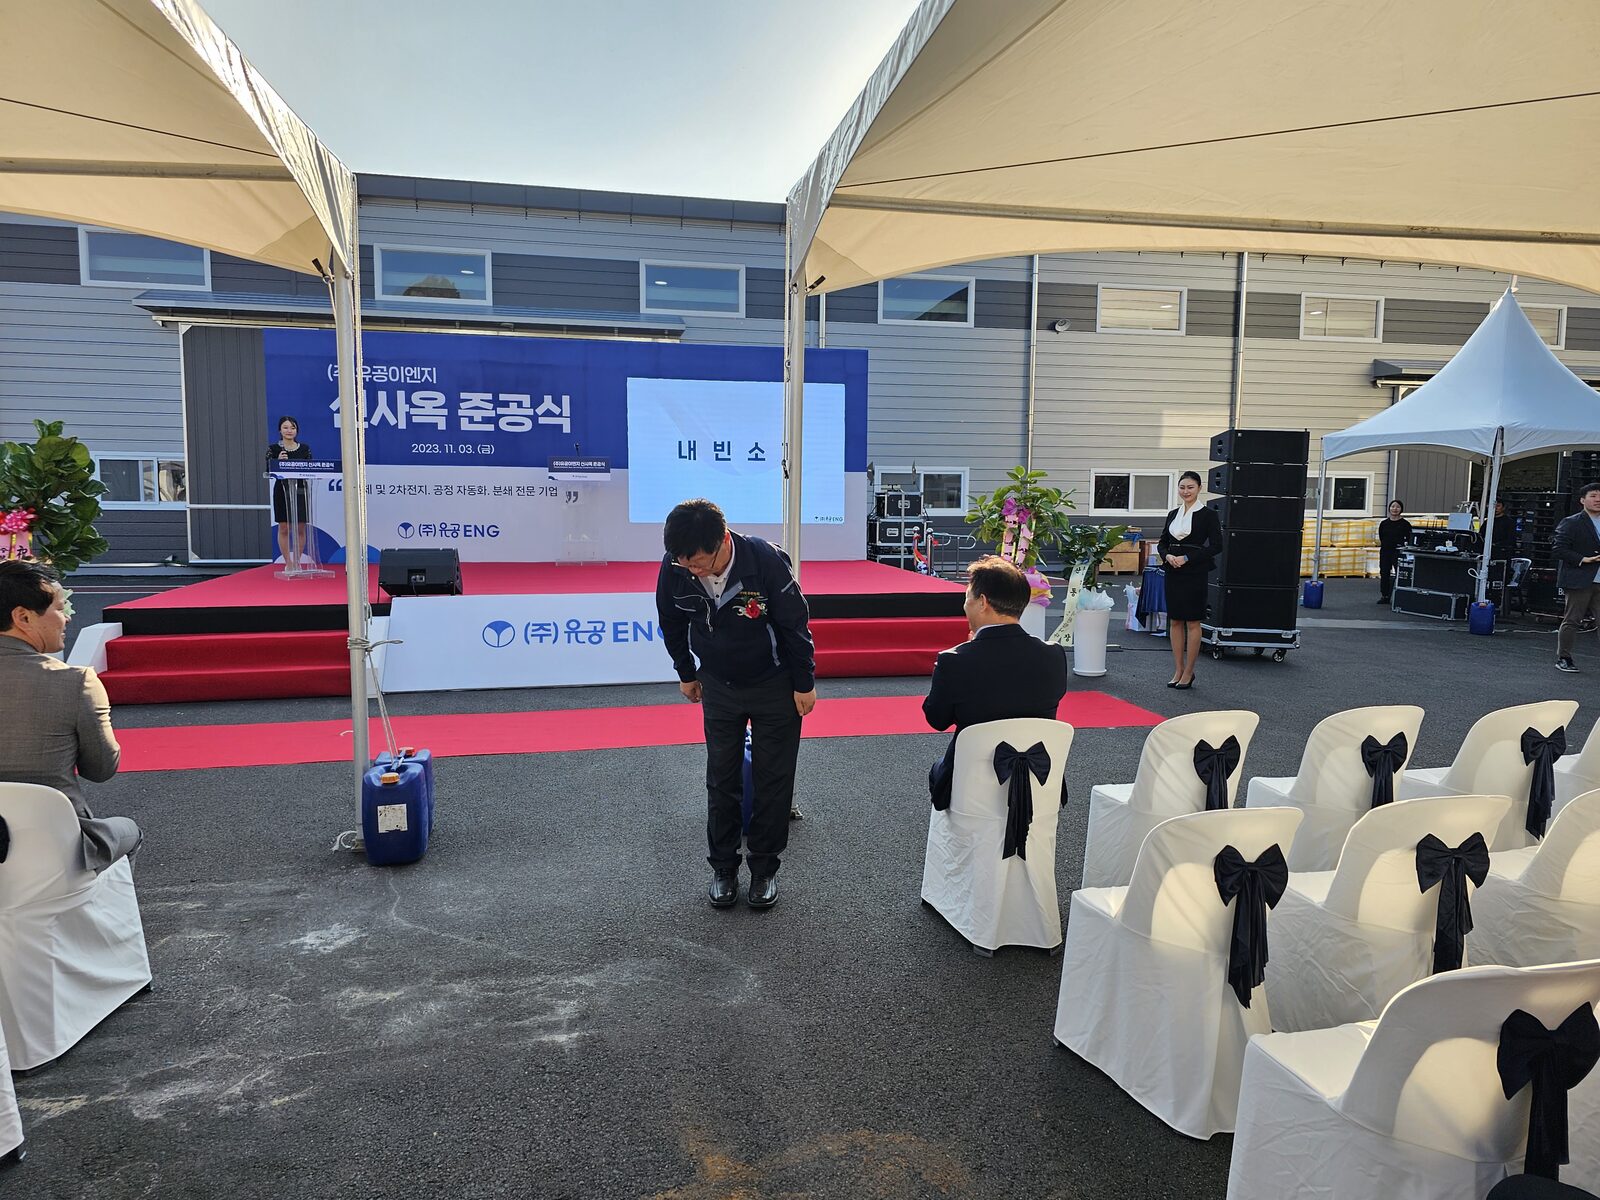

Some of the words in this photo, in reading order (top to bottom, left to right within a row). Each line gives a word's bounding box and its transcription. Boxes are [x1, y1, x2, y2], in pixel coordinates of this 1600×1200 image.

[458, 392, 571, 433] 준공식
[411, 443, 441, 454] 2023.
[444, 444, 456, 454] 11.
[458, 444, 475, 454] 03.
[477, 444, 495, 455] (금)
[375, 484, 386, 496] 및
[433, 484, 454, 496] 공정
[492, 485, 513, 497] 분쇄
[515, 485, 536, 497] 전문
[538, 485, 558, 497] 기업
[524, 619, 665, 645] (주)유공EN
